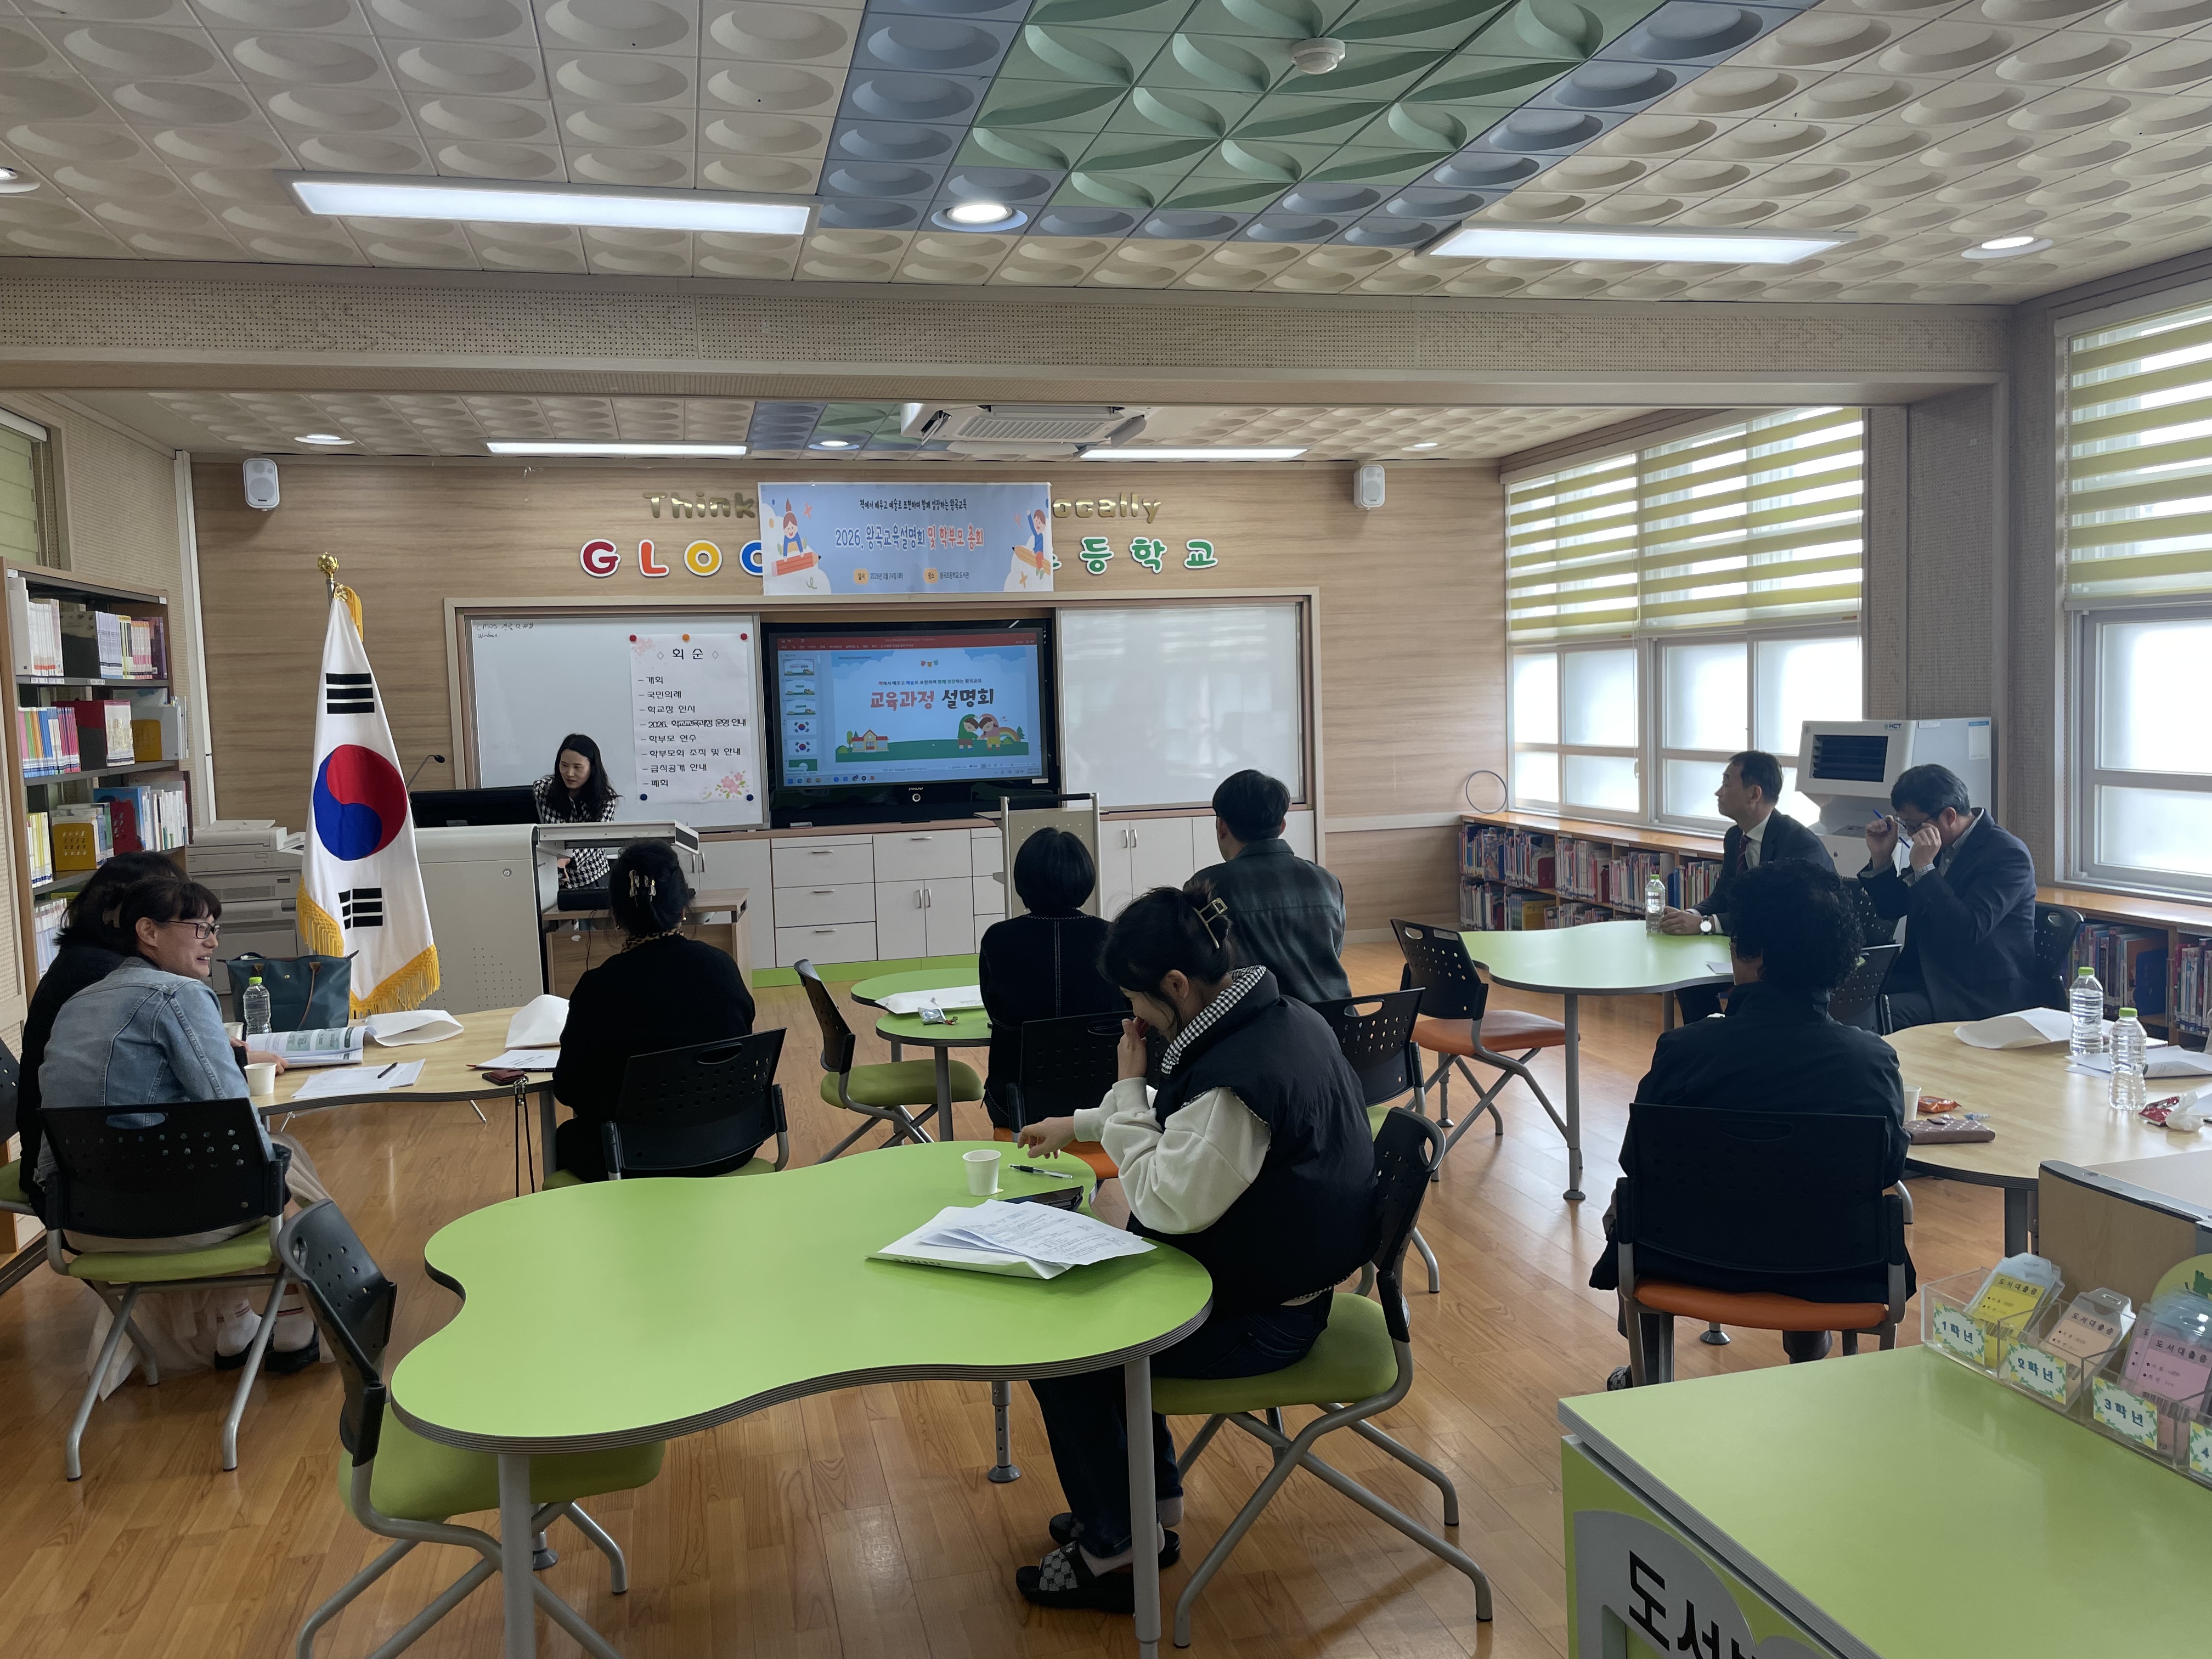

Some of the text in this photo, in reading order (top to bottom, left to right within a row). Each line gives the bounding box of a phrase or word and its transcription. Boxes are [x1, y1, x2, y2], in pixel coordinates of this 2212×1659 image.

[643, 492, 1162, 524] Think ocally
[834, 523, 984, 550] 2026. 왕곡교육설명회 및 학부모 총회
[646, 676, 663, 684] 개회
[647, 691, 681, 699] 국민의례
[870, 688, 994, 712] 교육과정 설명회
[647, 705, 696, 714] 학교장 인사
[715, 719, 730, 727] 운영
[731, 718, 746, 726] 안내
[649, 734, 697, 743] 학부모 연수
[650, 748, 741, 758] 학부모회 조직 및 안내
[651, 763, 707, 773] 급식공개 안내
[651, 779, 668, 787] 폐회
